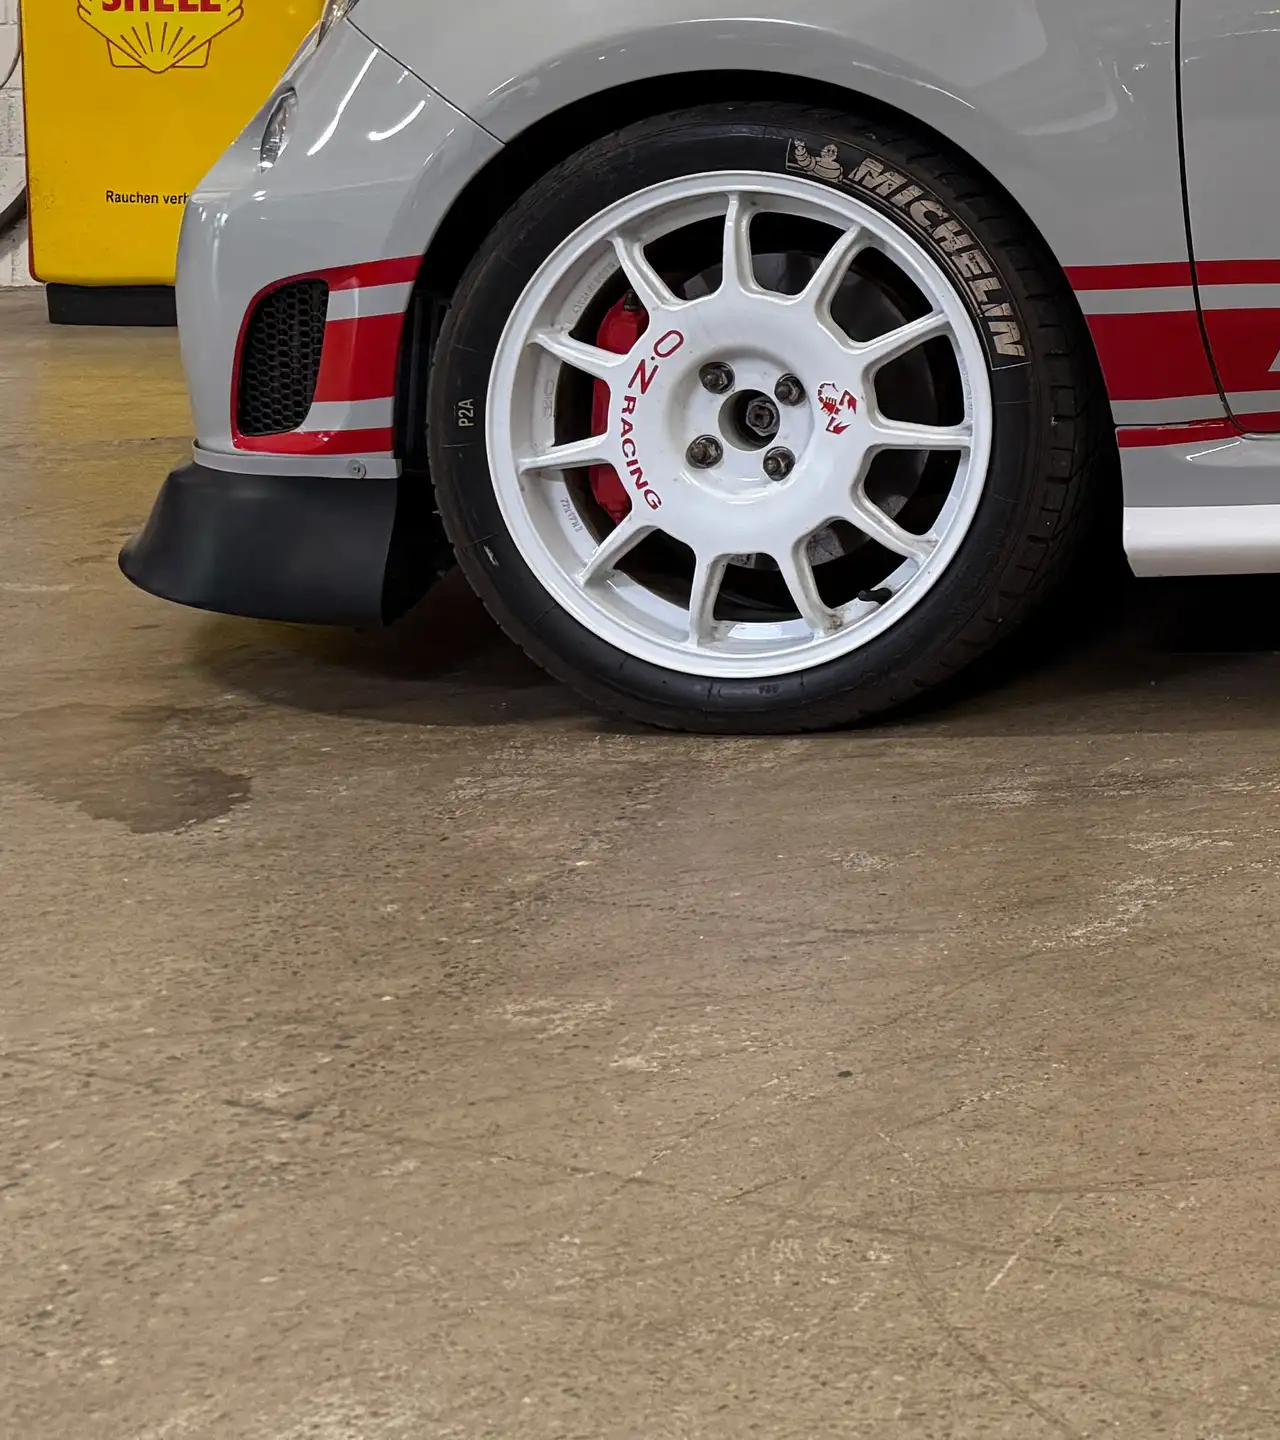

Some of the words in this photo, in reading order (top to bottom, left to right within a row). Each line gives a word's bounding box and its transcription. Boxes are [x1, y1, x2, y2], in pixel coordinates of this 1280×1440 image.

[105, 190, 159, 204] Rauchen
[848, 157, 1025, 357] MICHELIN
[458, 399, 474, 427] P2A
[620, 394, 662, 511] RACING
